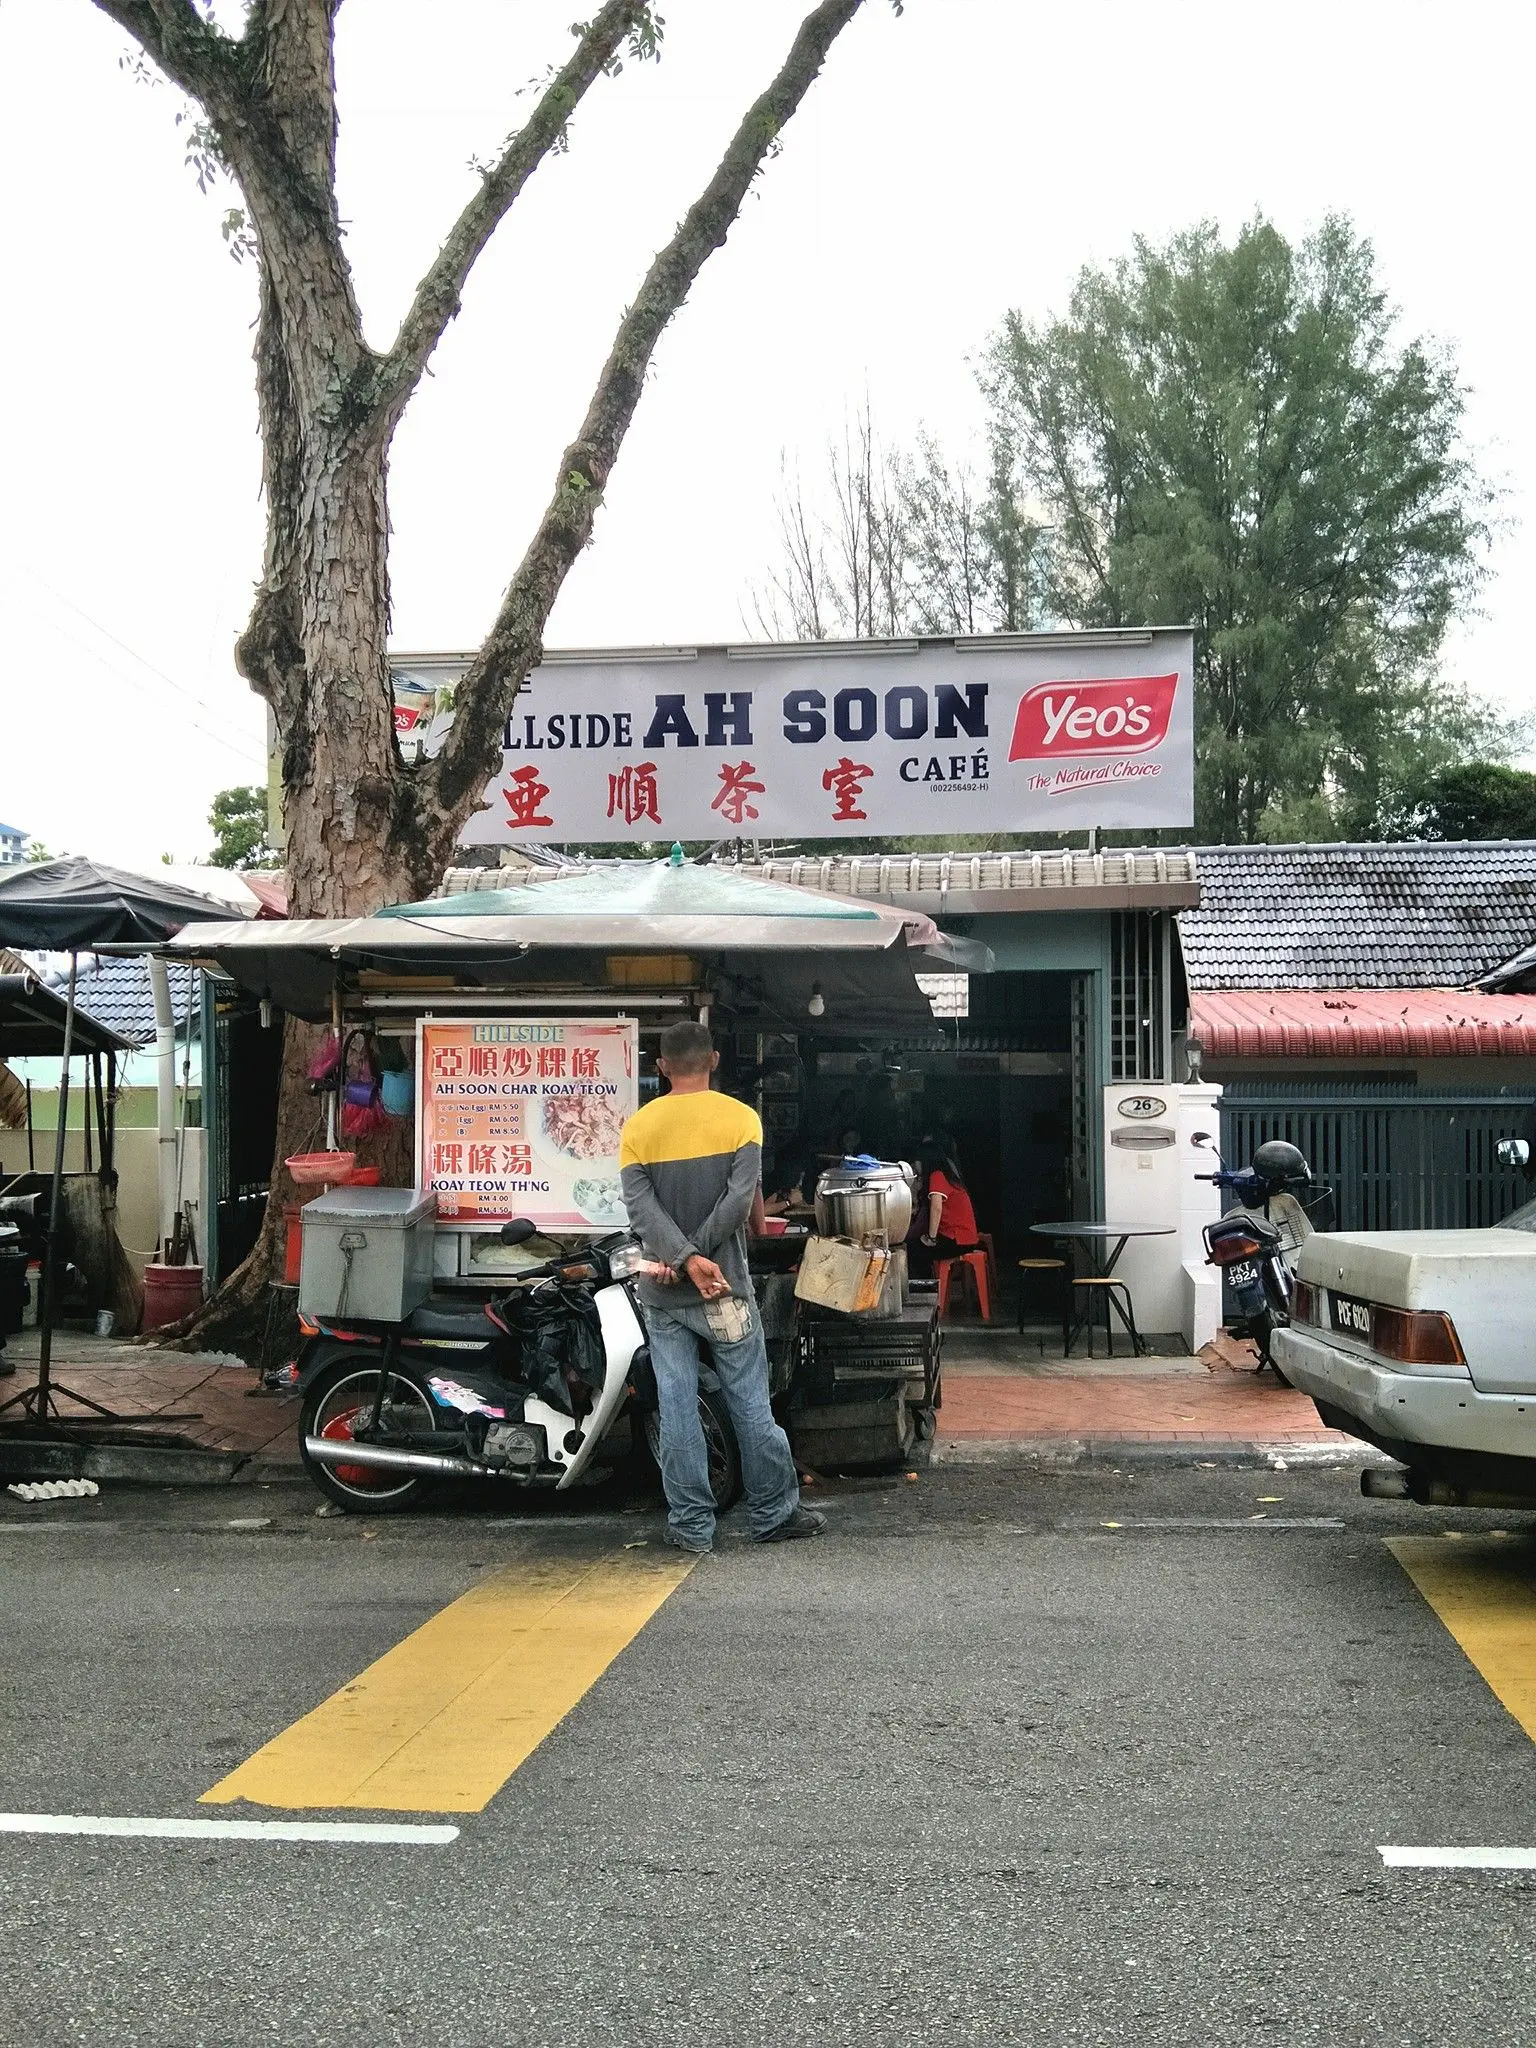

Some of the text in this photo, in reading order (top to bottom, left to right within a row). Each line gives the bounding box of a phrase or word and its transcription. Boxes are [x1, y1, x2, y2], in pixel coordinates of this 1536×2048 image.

[502, 683, 989, 750] LLSIDE AH SOON
[1042, 695, 1153, 745] Yeo's
[900, 746, 990, 782] CAFÉ
[929, 782, 989, 793] (002256492-H)
[1027, 761, 1162, 792] The Natural Choice
[474, 1026, 564, 1042] HILLSIDE
[433, 1047, 601, 1078] 亞順炒粿條
[436, 1083, 618, 1095] AH SOON CHAR KOAY TEOW
[1132, 1099, 1152, 1110] 26
[433, 1143, 531, 1175] 粿條湯
[430, 1180, 550, 1192] KOAY TEOW TH'NG
[1228, 1268, 1258, 1285] 3924
[1229, 1261, 1250, 1275] PKT
[1337, 1299, 1351, 1327] PCF
